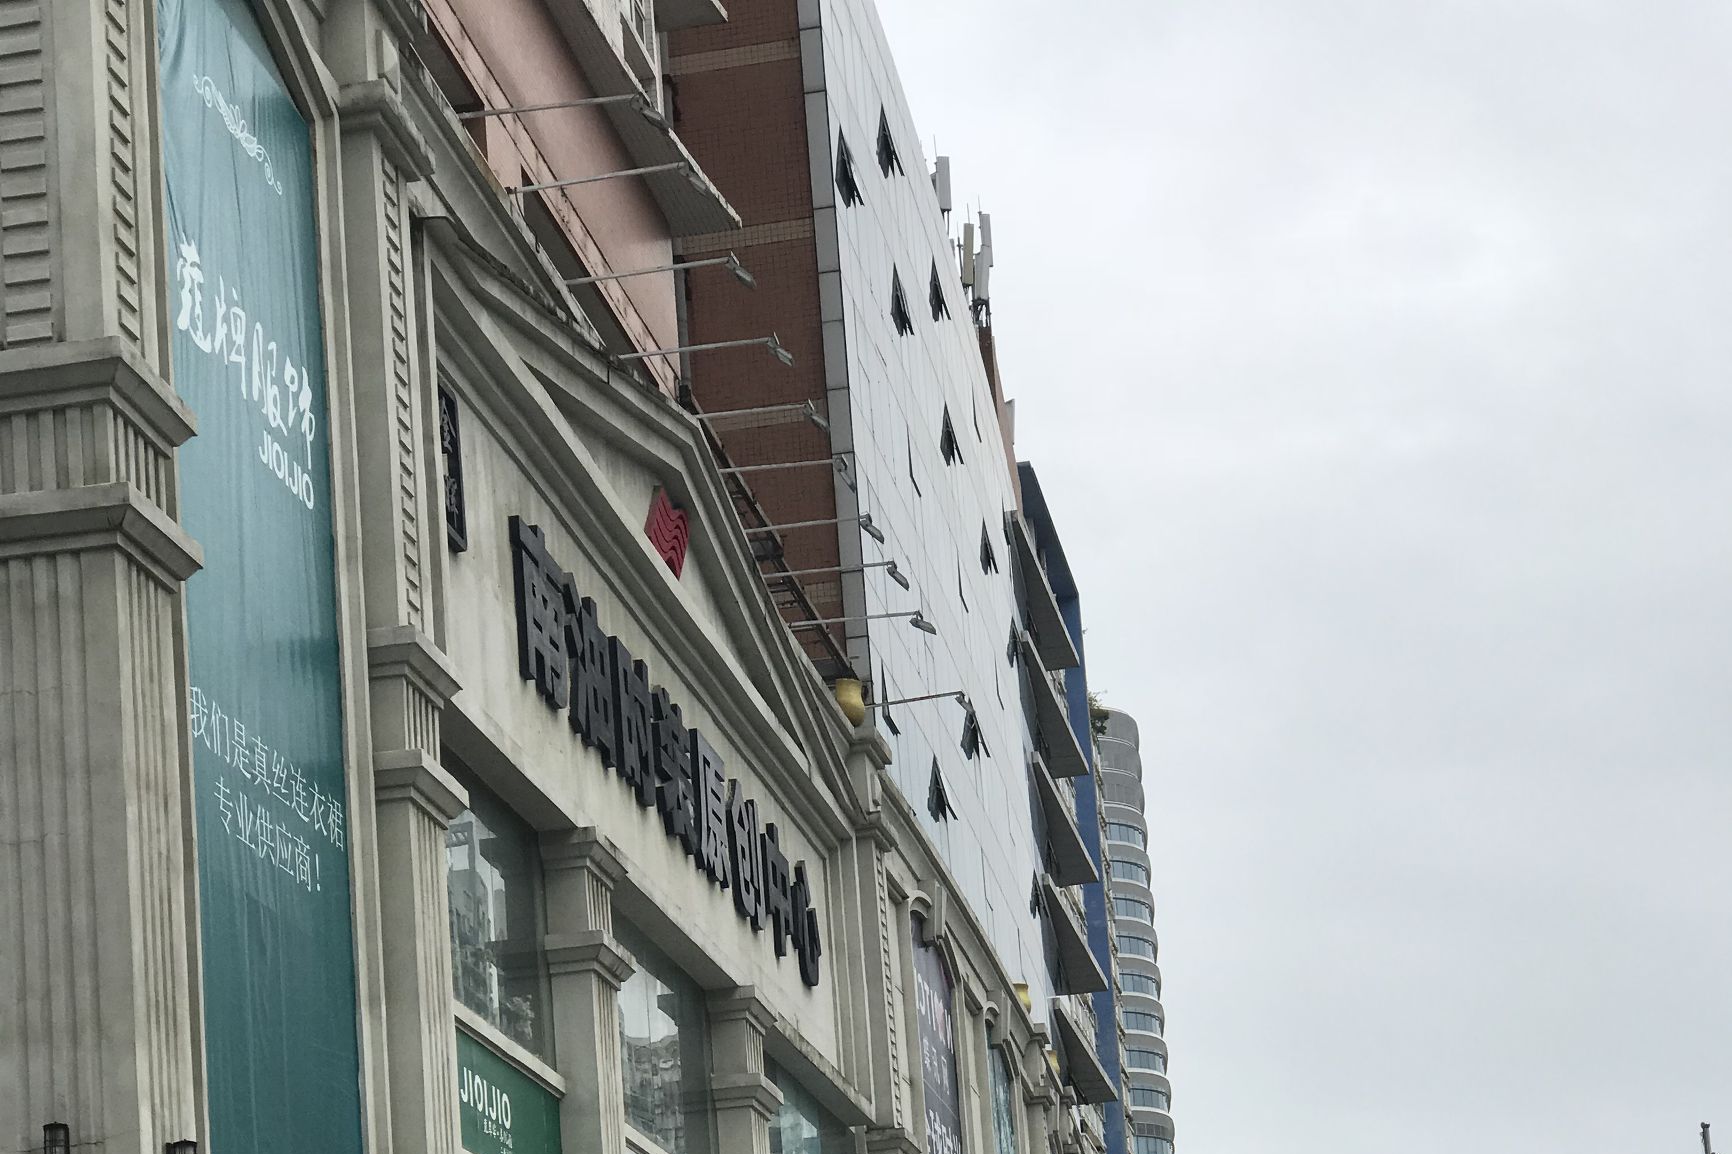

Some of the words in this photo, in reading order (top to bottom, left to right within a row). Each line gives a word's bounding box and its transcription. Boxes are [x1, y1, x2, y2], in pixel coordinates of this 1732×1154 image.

[190, 686, 343, 851] 我们是真丝连衣裙
[508, 515, 821, 987] 南油时装原创中心
